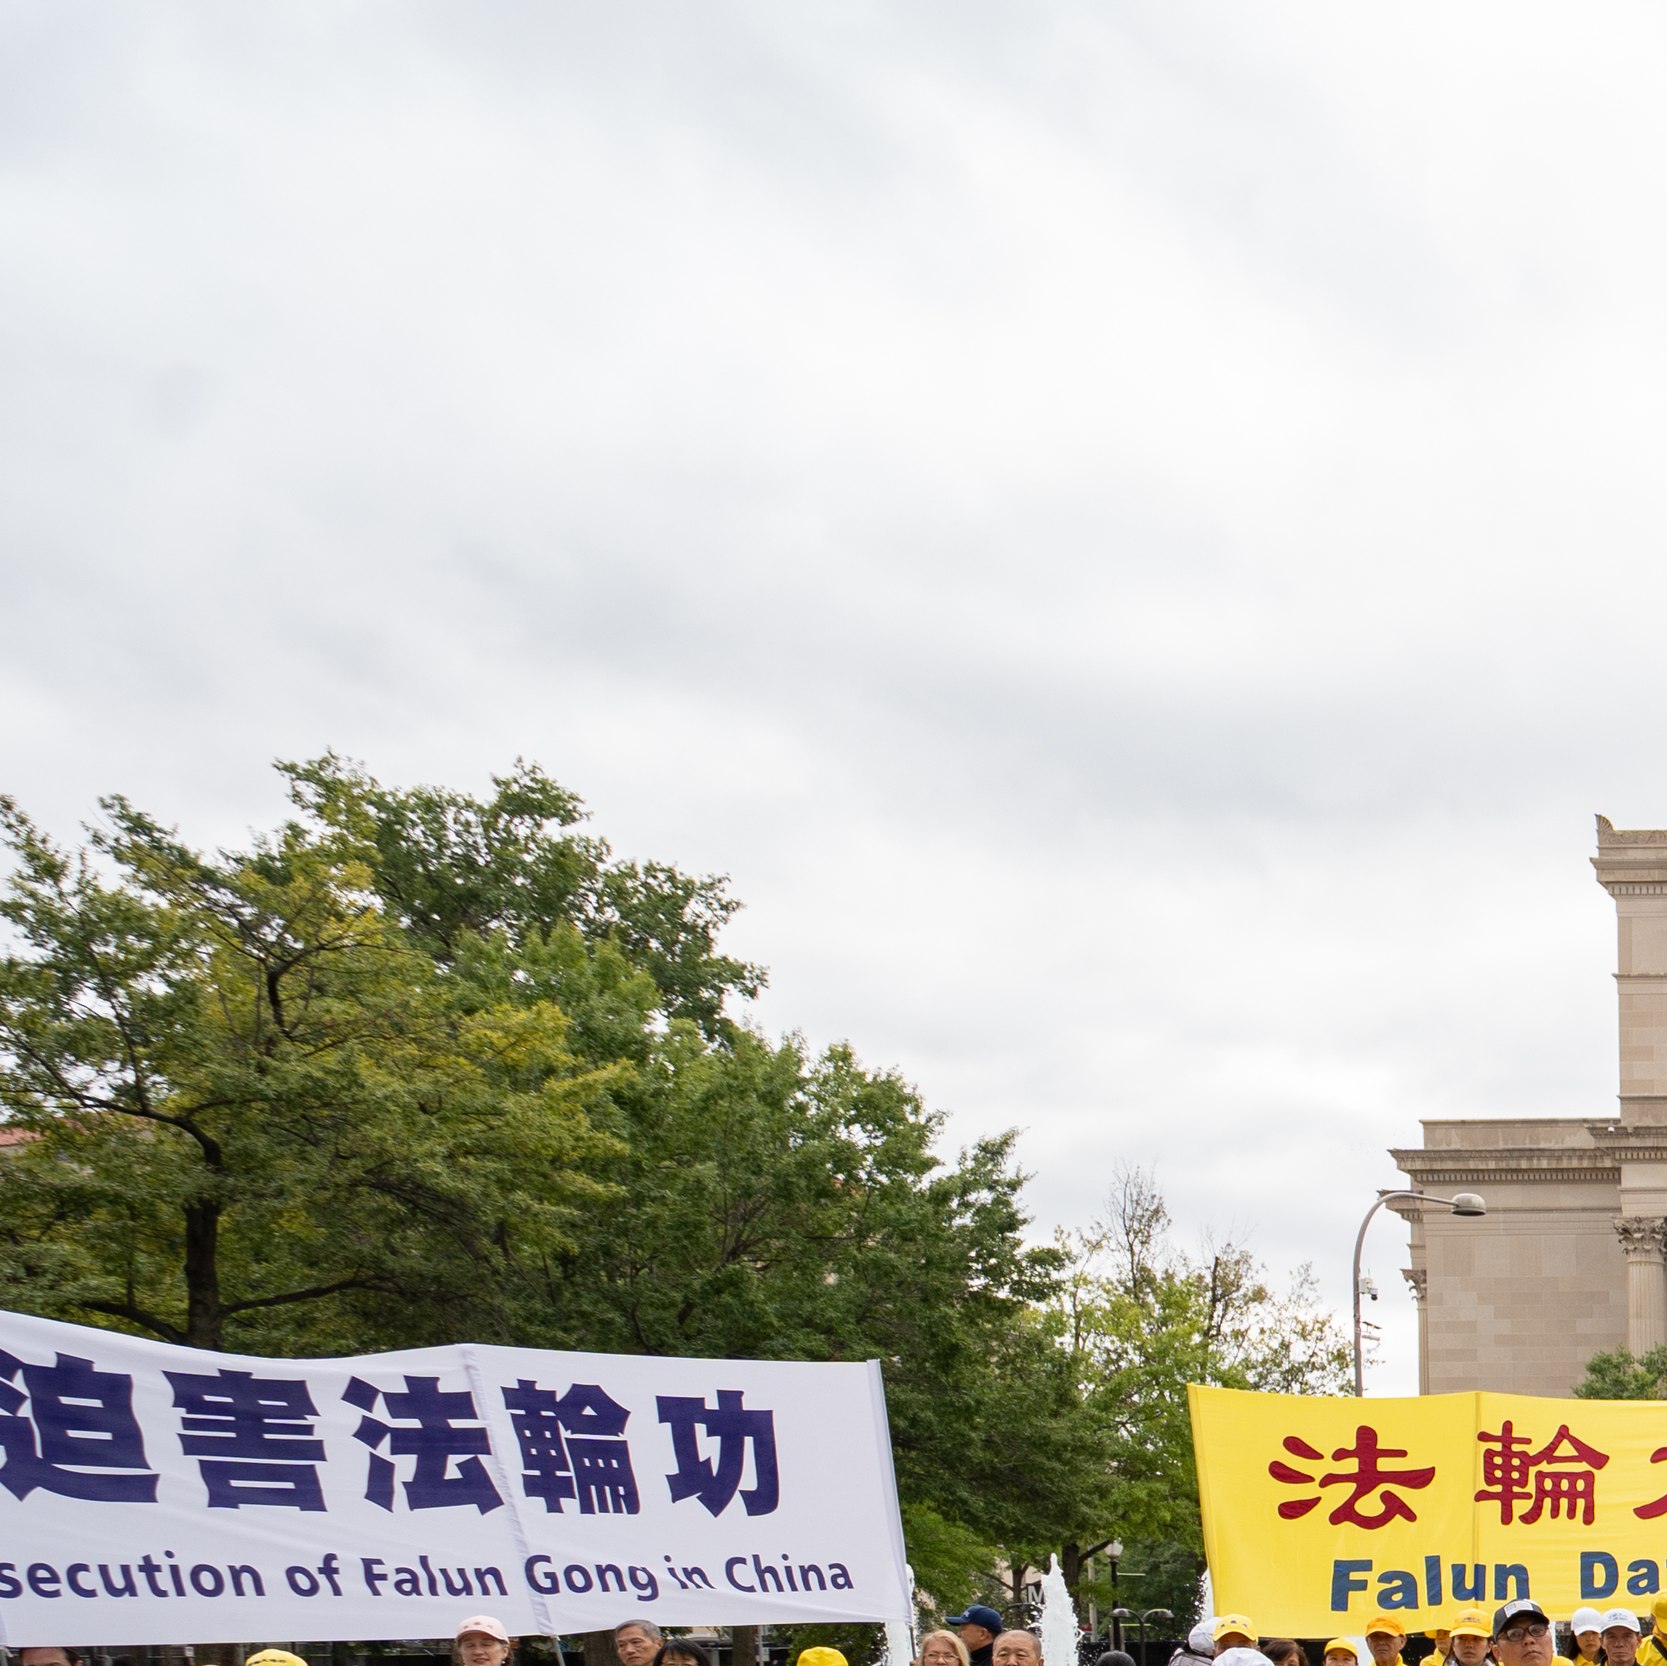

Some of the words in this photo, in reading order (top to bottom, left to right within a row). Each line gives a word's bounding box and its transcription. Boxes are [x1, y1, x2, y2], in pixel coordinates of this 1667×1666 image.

[0, 1348, 782, 1518] 迫害法輪功
[285, 1552, 343, 1597] of
[361, 1556, 508, 1598] Falun
[524, 1554, 660, 1602] Gong
[663, 1554, 717, 1590] in
[724, 1553, 854, 1593] China
[1330, 1554, 1531, 1612] Falun
